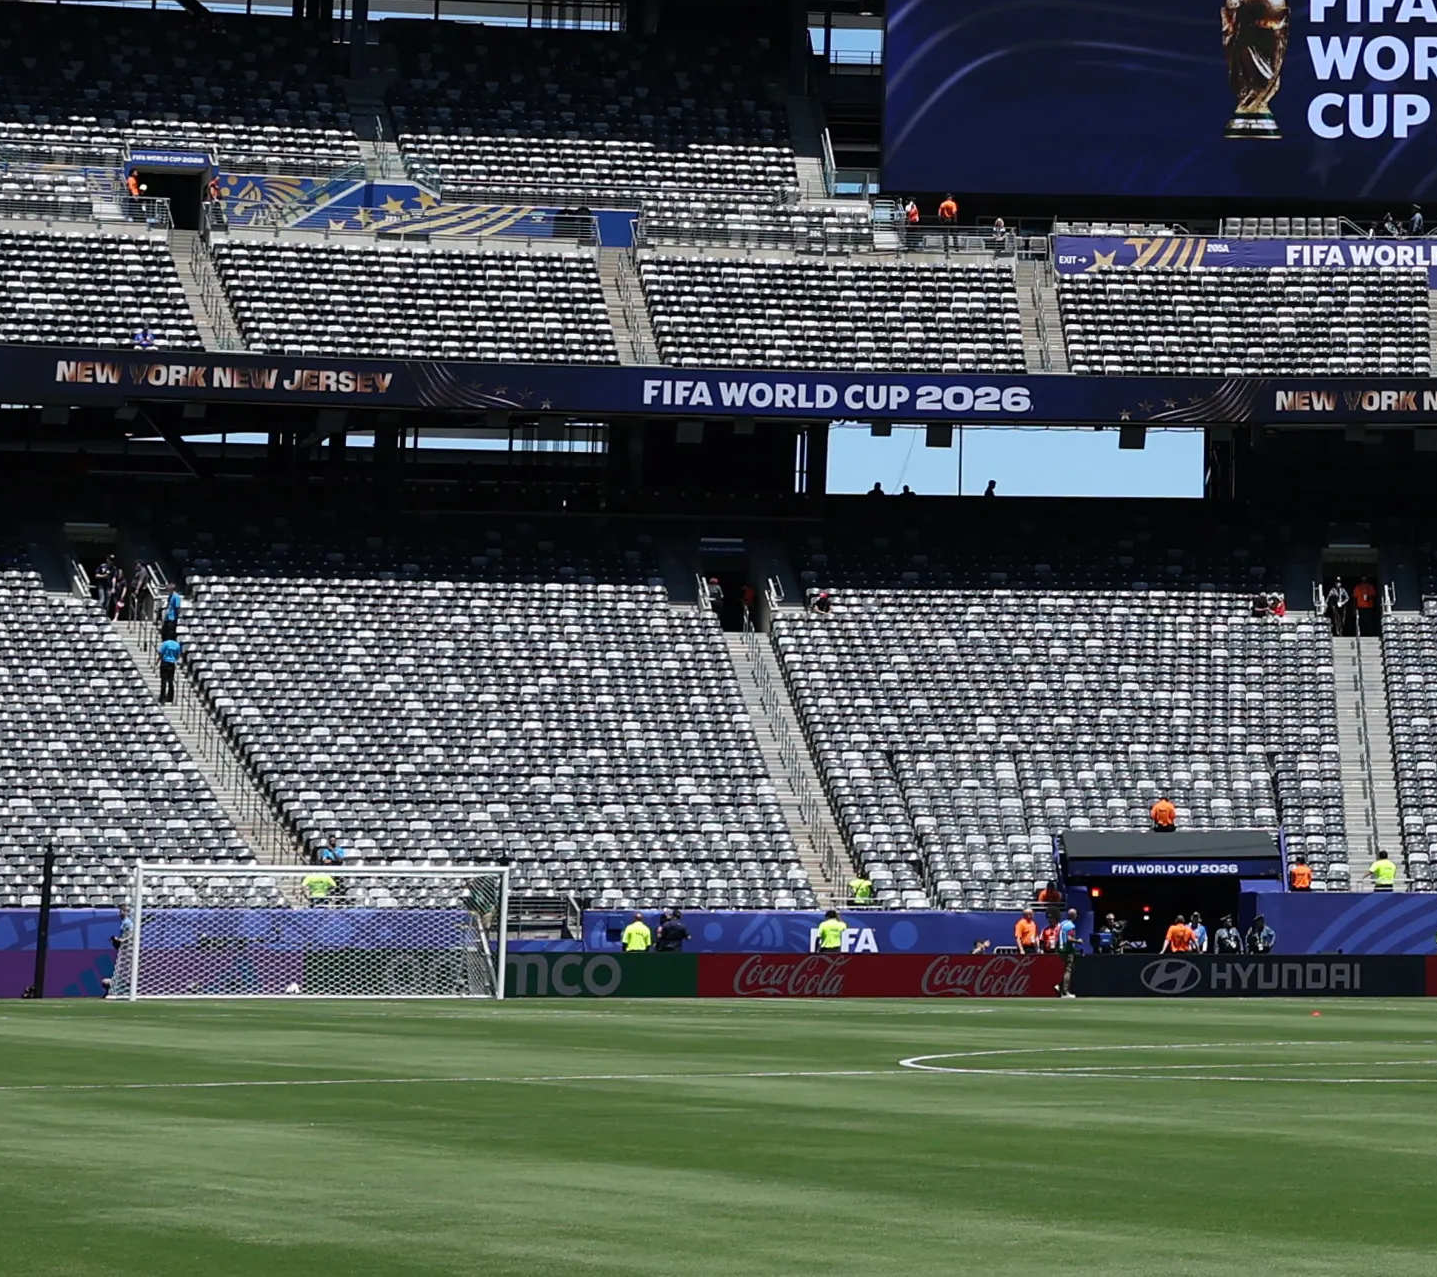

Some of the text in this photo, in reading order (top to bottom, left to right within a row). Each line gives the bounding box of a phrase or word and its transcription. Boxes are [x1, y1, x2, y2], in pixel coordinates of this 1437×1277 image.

[1307, 92, 1421, 140] CUP
[1058, 256, 1077, 265] EXIT
[1285, 243, 1350, 268] FIFA
[56, 360, 394, 394] NEW YORK NEW JERSEY
[642, 379, 1032, 412] FIFA WORLD CUP 2026
[1275, 390, 1338, 412] NEW
[1343, 390, 1419, 413] YORK
[1111, 864, 1239, 875] FIFA WORLD CUP 2026
[809, 928, 879, 953] FFA
[1210, 962, 1362, 990] HYUNDAI
